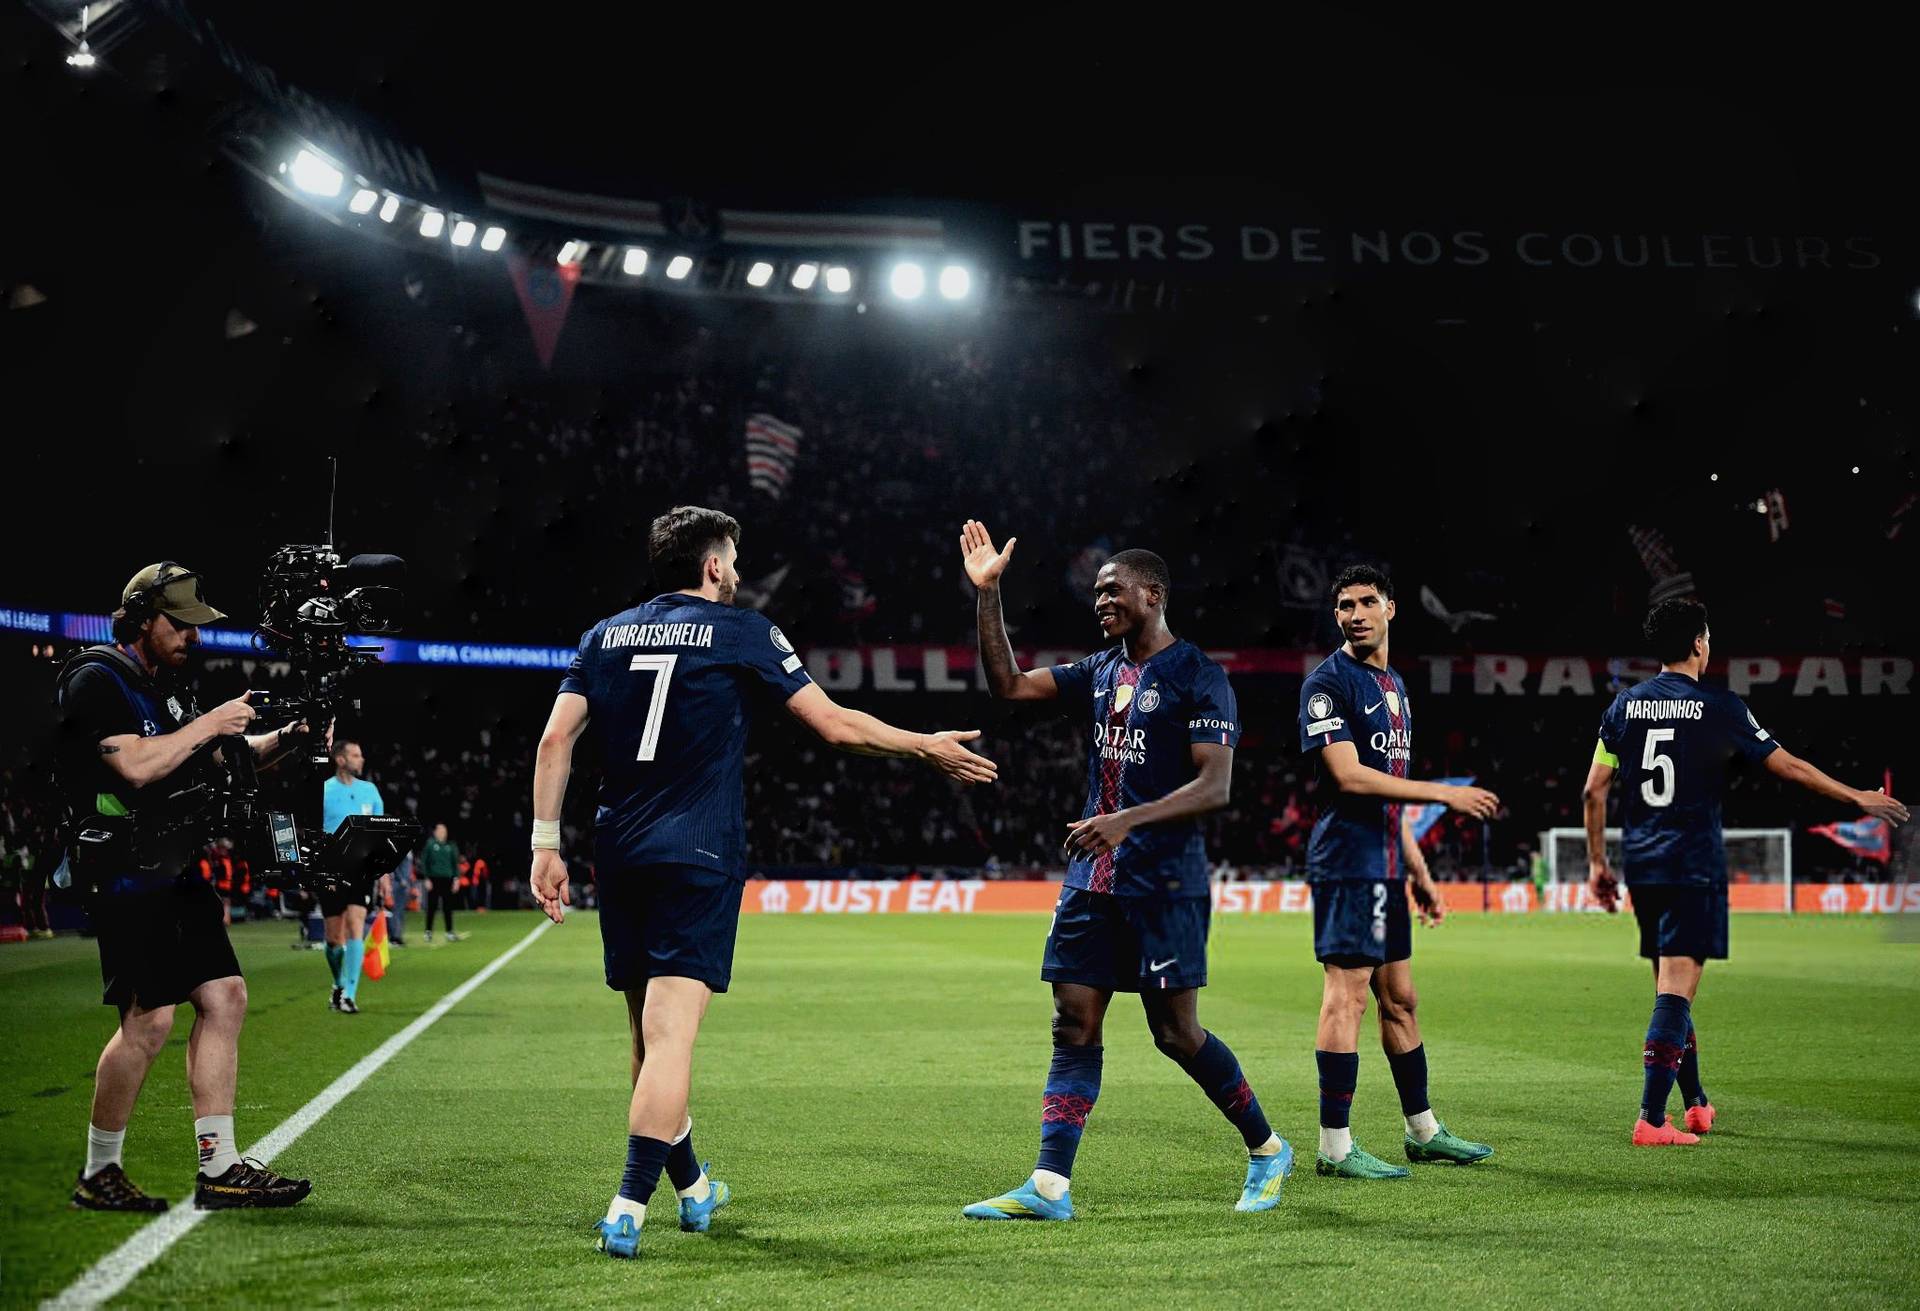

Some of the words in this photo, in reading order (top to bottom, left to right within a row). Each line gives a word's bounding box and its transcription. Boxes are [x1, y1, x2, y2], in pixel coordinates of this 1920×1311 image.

[1018, 220, 1215, 261] FIERS
[1240, 225, 1326, 264] DE
[1351, 230, 1490, 266] NOS
[1516, 232, 1881, 270] COULEURS
[601, 622, 714, 649] KVARATSKHELIA
[418, 643, 459, 662] UEFA
[629, 653, 679, 762] 7
[1625, 699, 1704, 721] MARQUINHOS
[1094, 722, 1146, 750] QATAR
[1188, 718, 1235, 731] BEYOND
[1100, 745, 1146, 765] AIRWAYS
[1640, 728, 1676, 808] 5
[802, 880, 901, 913] JUST
[907, 880, 986, 913] EAT
[1373, 883, 1388, 920] 2
